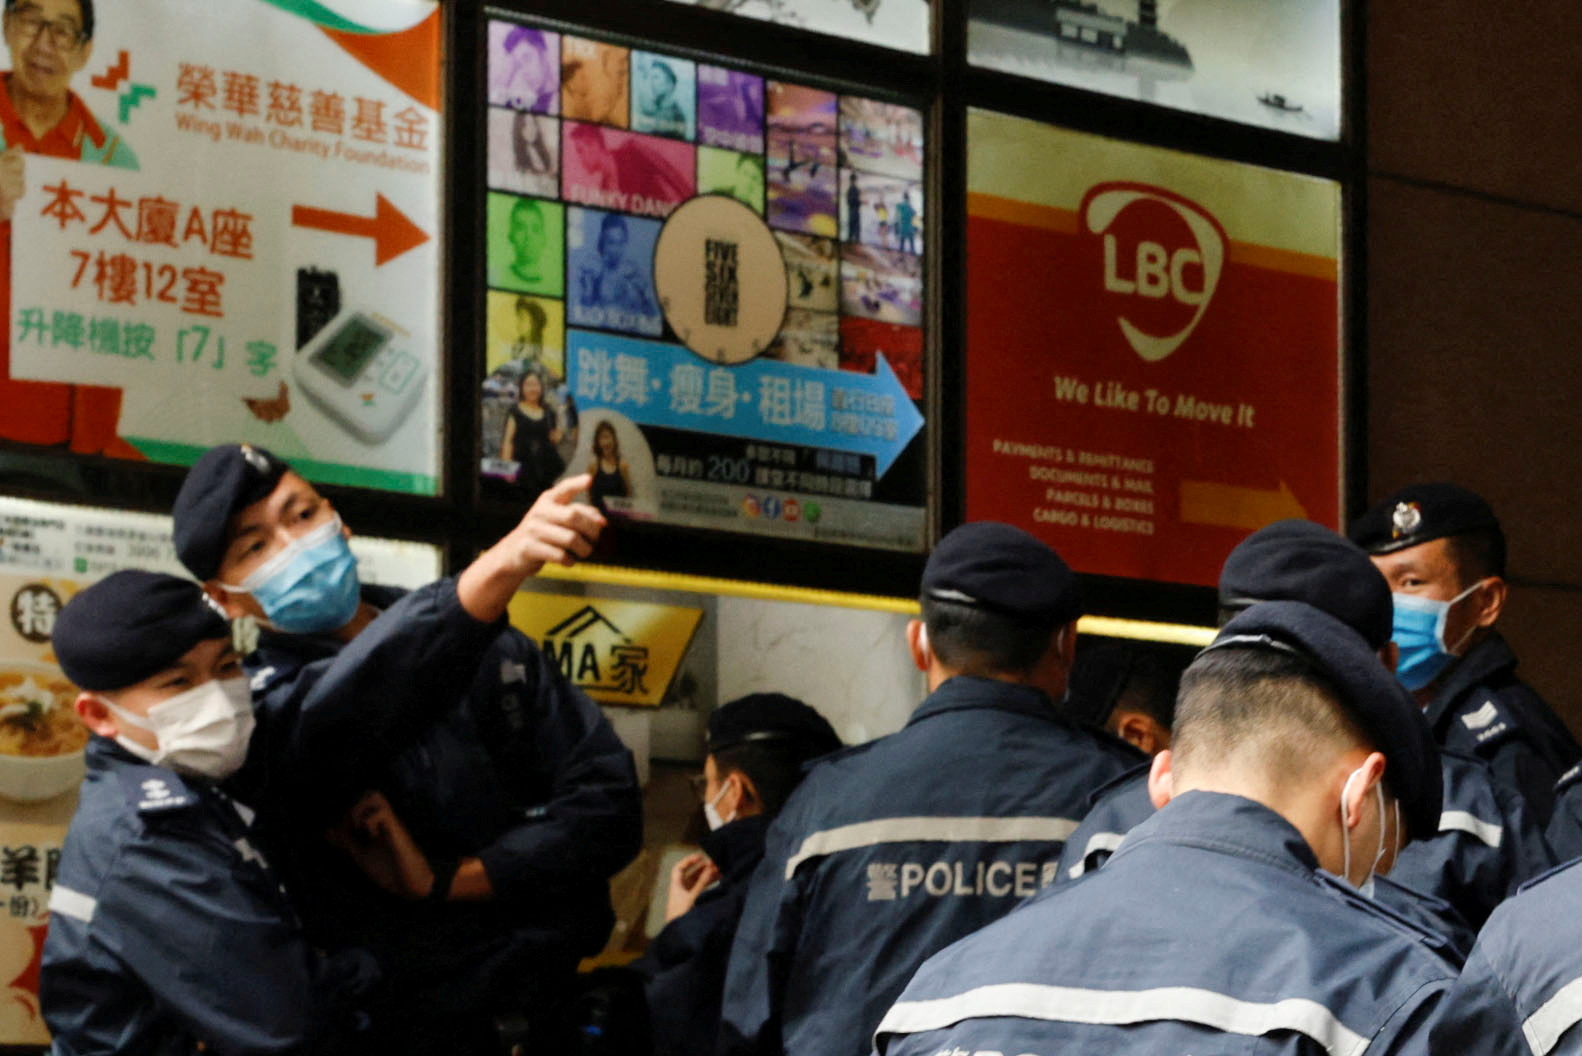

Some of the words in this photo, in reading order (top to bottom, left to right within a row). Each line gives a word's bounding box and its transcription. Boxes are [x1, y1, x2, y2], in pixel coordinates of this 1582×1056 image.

[176, 63, 429, 150] 榮華慈善基金
[175, 111, 222, 142] Wing
[225, 122, 265, 144] Wah
[267, 129, 330, 160] Charity
[334, 142, 431, 175] Foundation
[40, 179, 254, 260] 本大廈A座
[70, 249, 225, 318] 7樓12室
[1104, 234, 1205, 306] LBC
[1054, 376, 1089, 404] We
[1094, 381, 1140, 411] Like
[1144, 388, 1170, 416] To
[1174, 394, 1233, 425] Move
[1238, 403, 1255, 428] It
[992, 438, 1063, 463] PAYMENTS
[1029, 465, 1108, 488] DOCUMENTS
[1033, 507, 1078, 526] CARGO
[1046, 487, 1099, 508] PARCELS
[17, 590, 56, 635] 特
